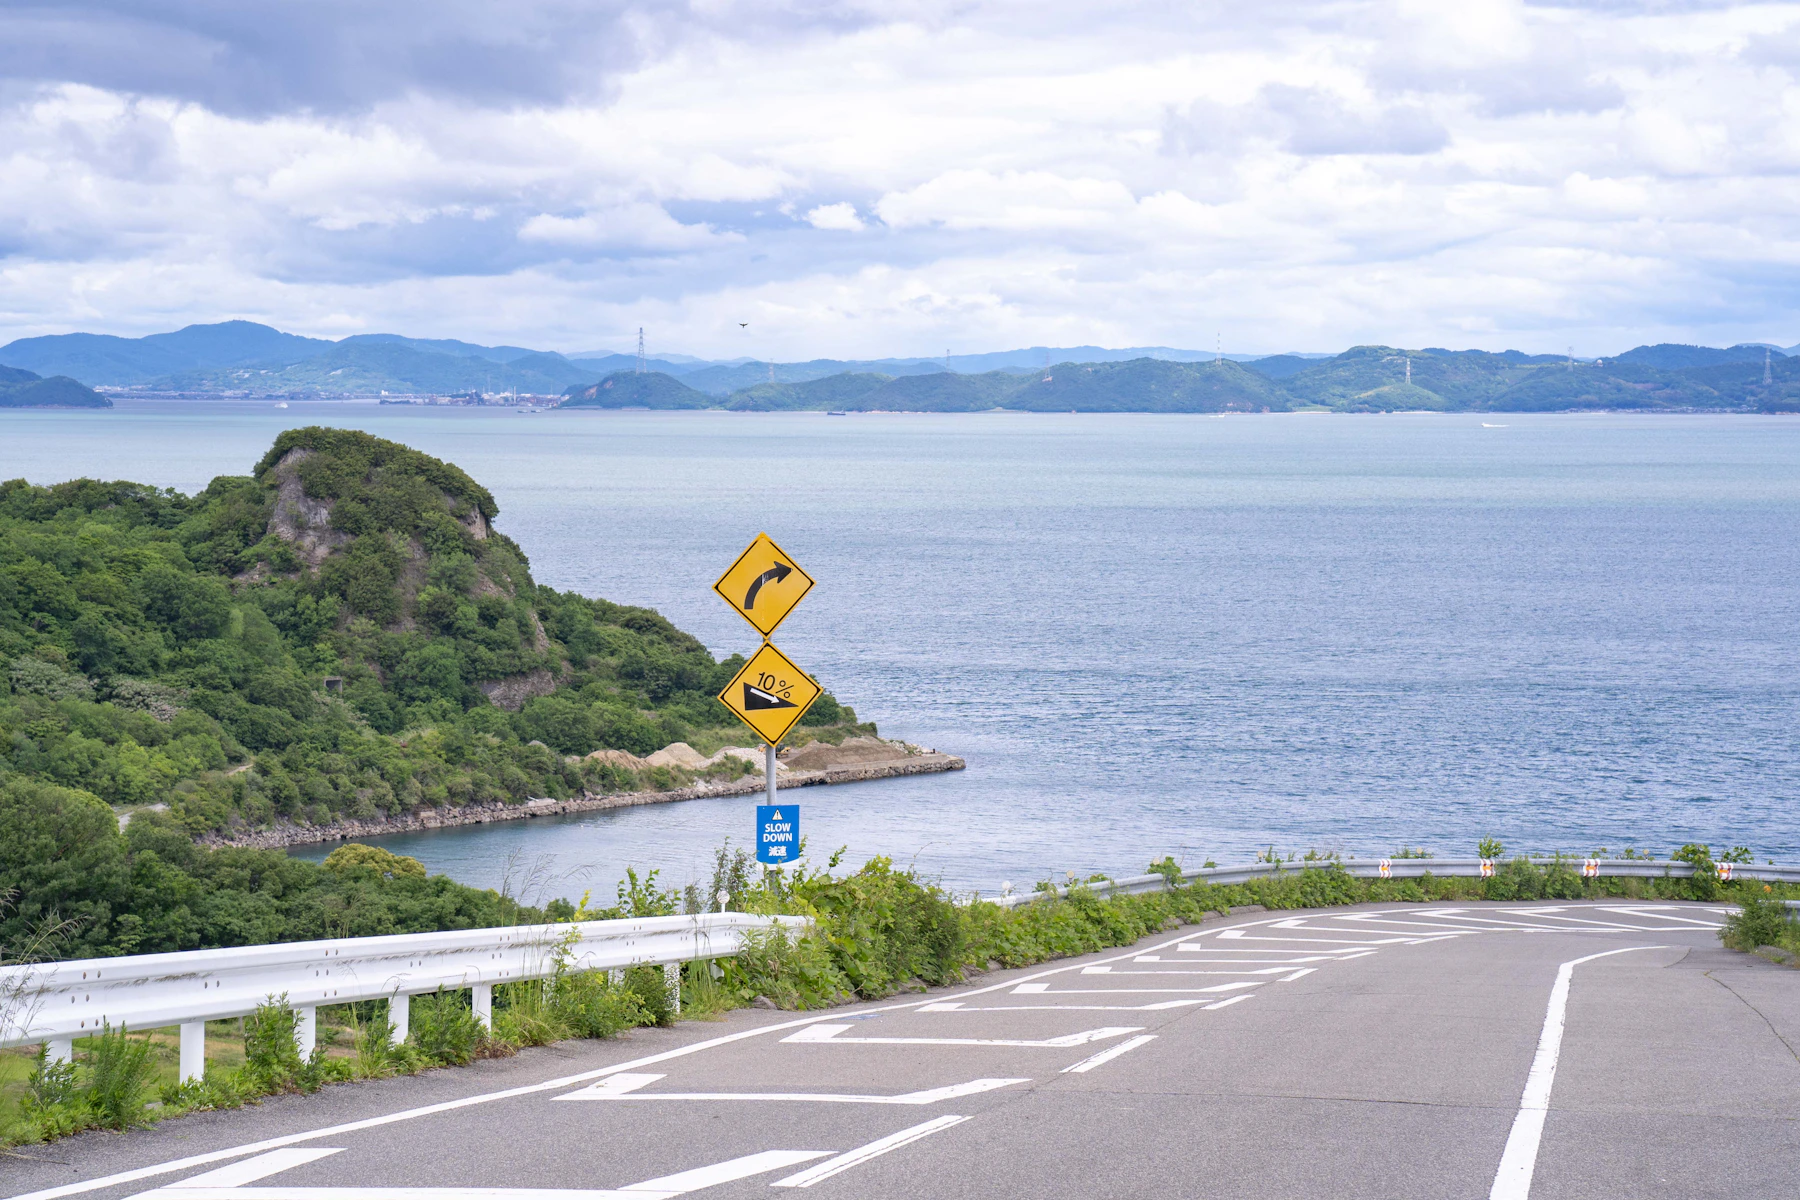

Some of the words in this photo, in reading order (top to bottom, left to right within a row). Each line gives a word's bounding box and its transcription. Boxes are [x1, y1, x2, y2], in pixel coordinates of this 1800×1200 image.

[757, 671, 794, 699] 10%
[764, 823, 791, 832] SLOW
[763, 833, 793, 842] DOWN
